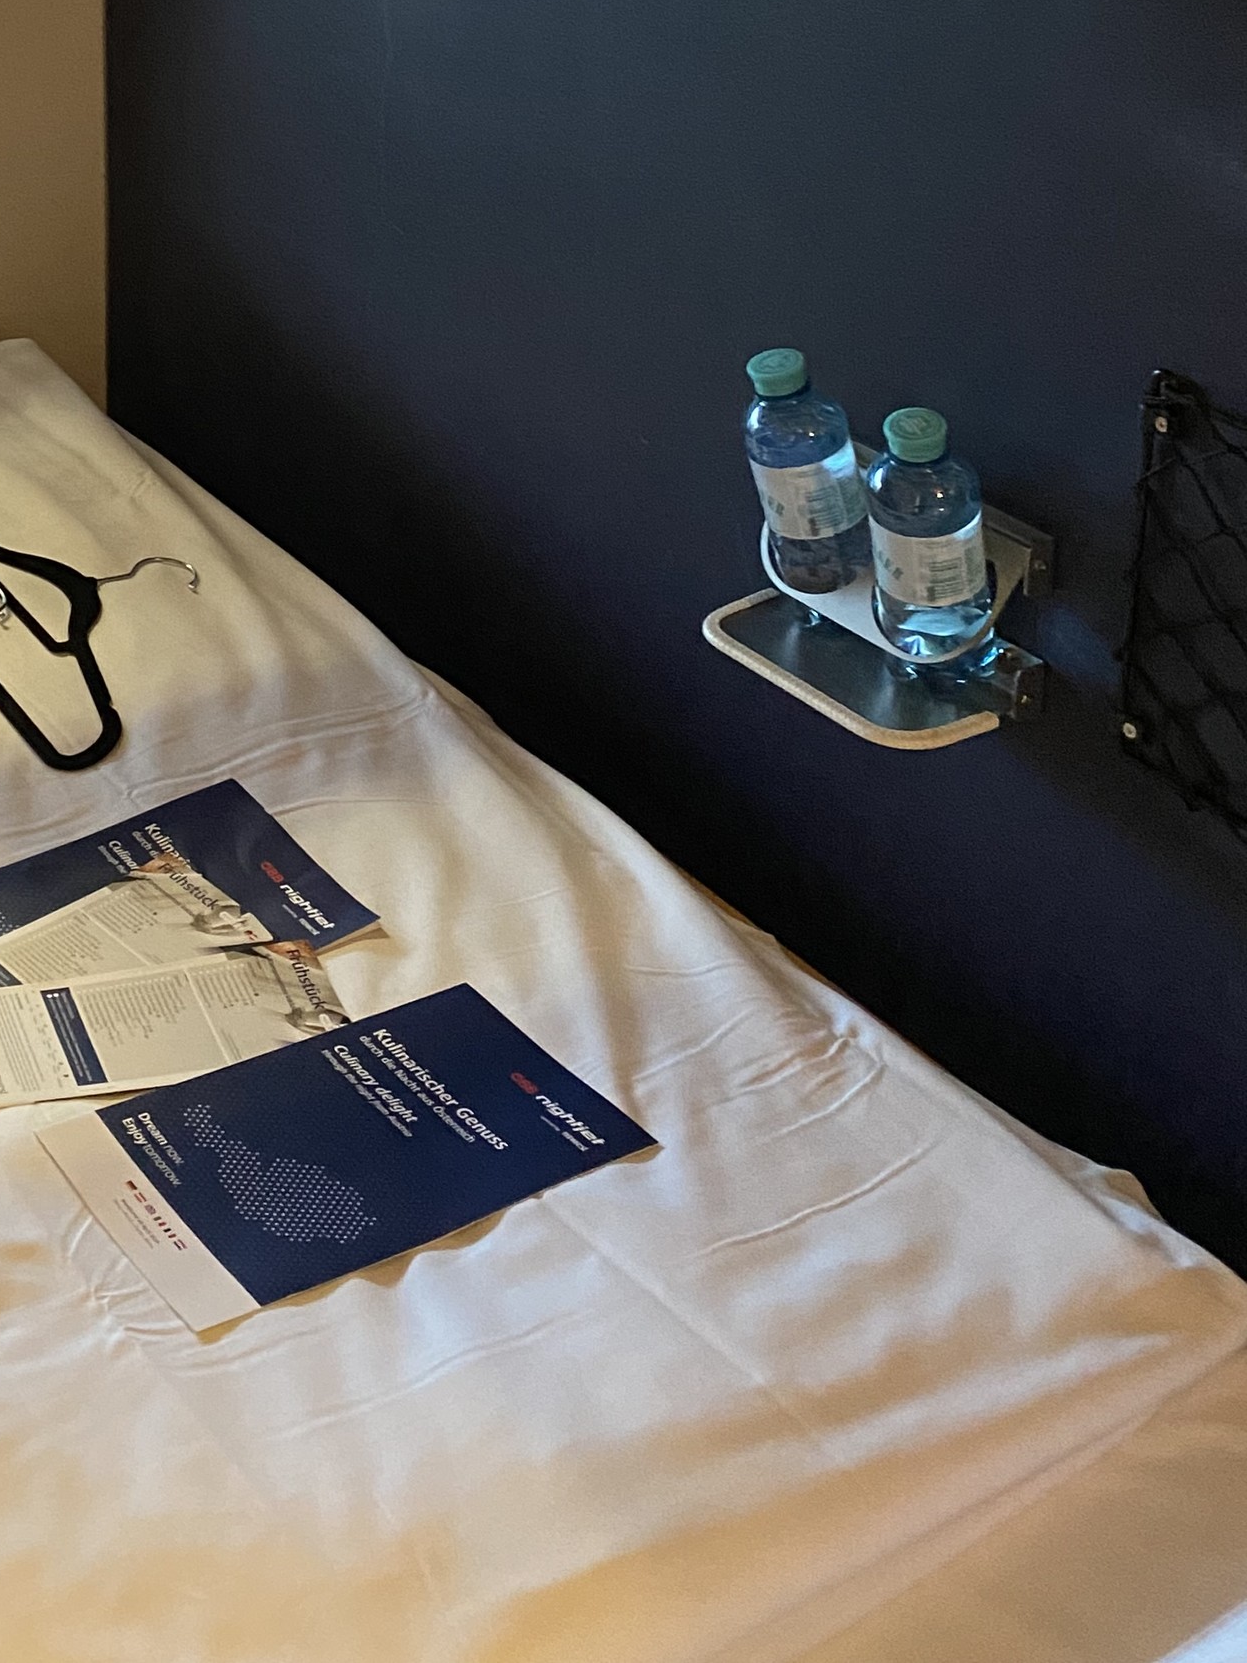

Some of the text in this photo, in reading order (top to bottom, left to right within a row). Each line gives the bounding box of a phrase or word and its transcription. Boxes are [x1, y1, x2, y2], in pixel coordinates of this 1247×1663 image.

[109, 840, 140, 870] Culinar
[158, 862, 222, 911] Frühstück
[279, 884, 335, 929] nightjet
[287, 949, 328, 1010] Frühstück
[334, 1045, 418, 1122] Culinary delight
[359, 1035, 476, 1143] durch die Nacht aus Österreich
[373, 1028, 459, 1106] Kulinarischer
[456, 1107, 509, 1151] Genuss
[122, 1118, 148, 1145] Enjoy
[138, 1112, 168, 1145] Dream
[535, 1095, 605, 1145] nightjet
